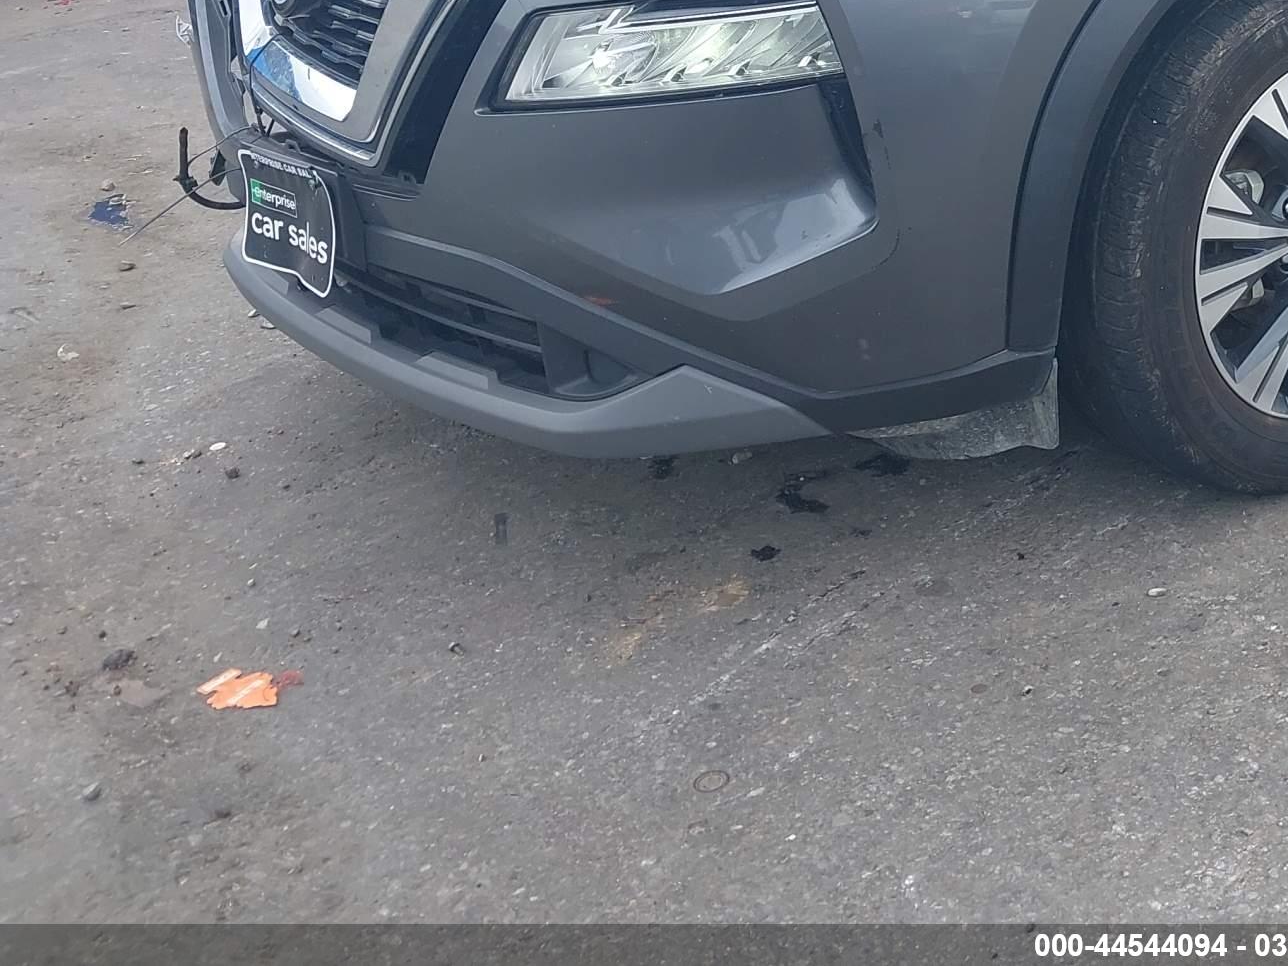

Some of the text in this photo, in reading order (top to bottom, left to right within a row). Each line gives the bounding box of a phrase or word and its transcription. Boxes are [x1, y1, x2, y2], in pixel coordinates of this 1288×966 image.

[253, 185, 296, 210] enterprise
[251, 212, 328, 264] car sales
